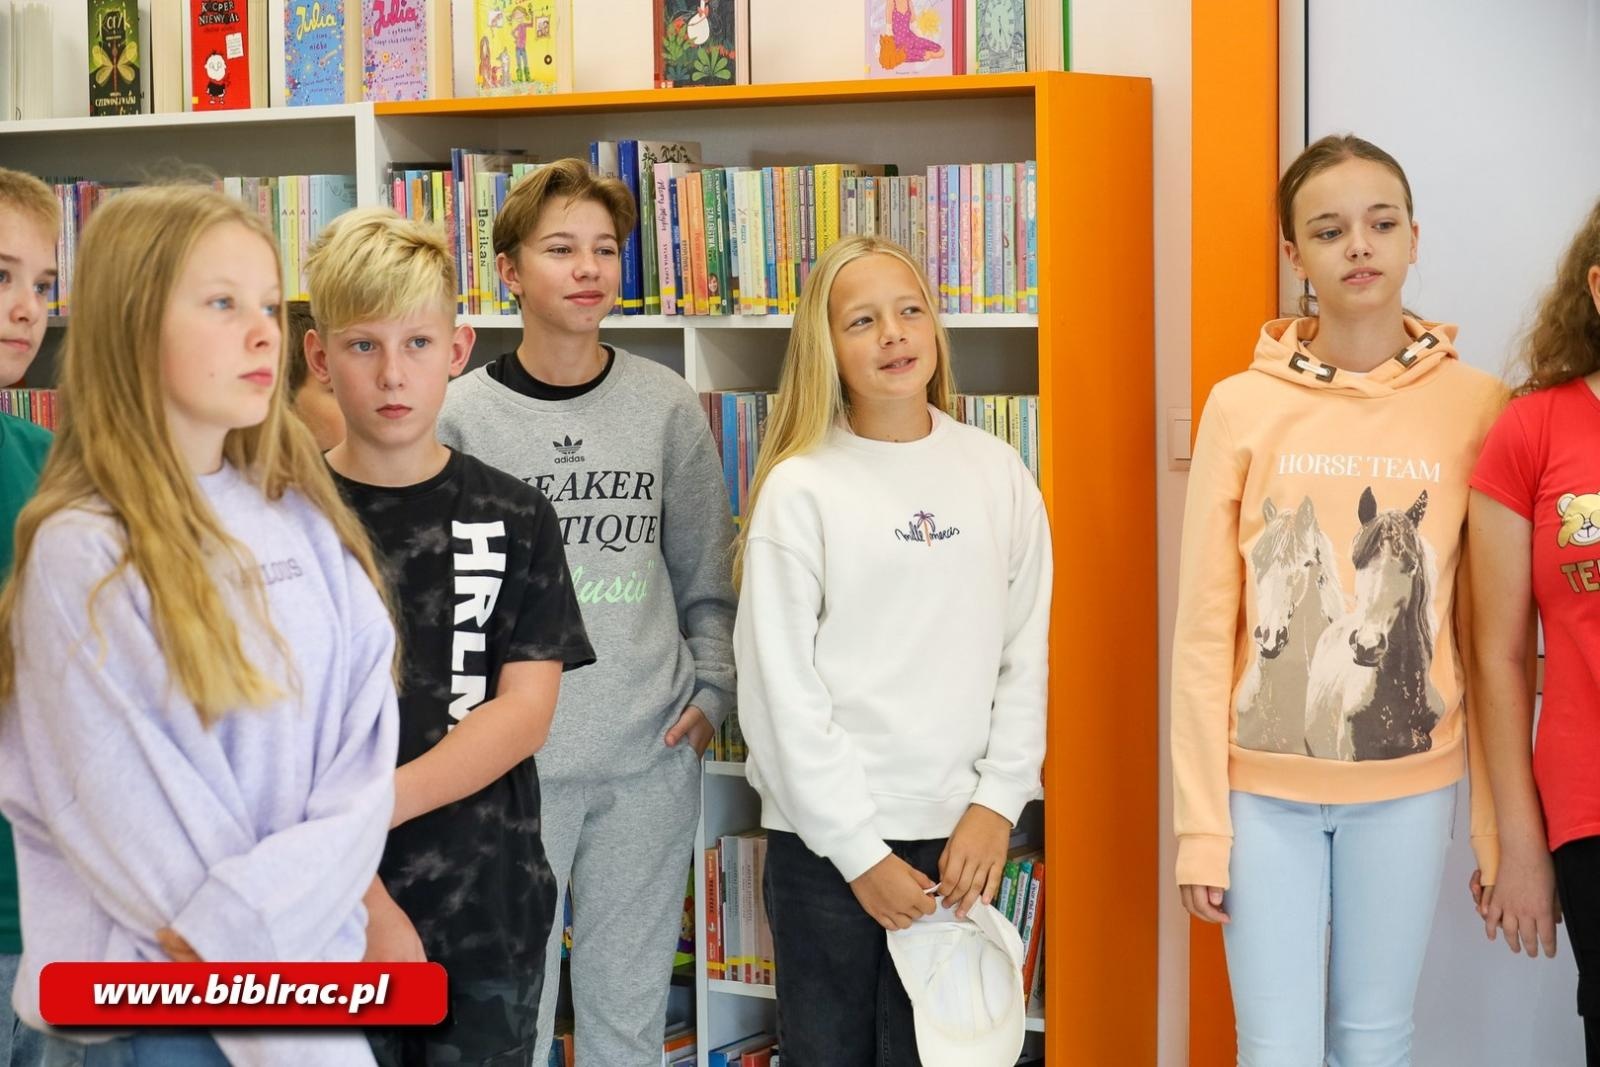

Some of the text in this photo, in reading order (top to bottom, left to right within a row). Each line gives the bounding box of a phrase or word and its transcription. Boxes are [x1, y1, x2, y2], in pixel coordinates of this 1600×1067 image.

[554, 453, 586, 464] adidas
[1278, 452, 1441, 483] HORSE TEAM
[521, 470, 655, 502] EAKER
[559, 514, 658, 553] TIQUE
[1561, 559, 1600, 594] TE
